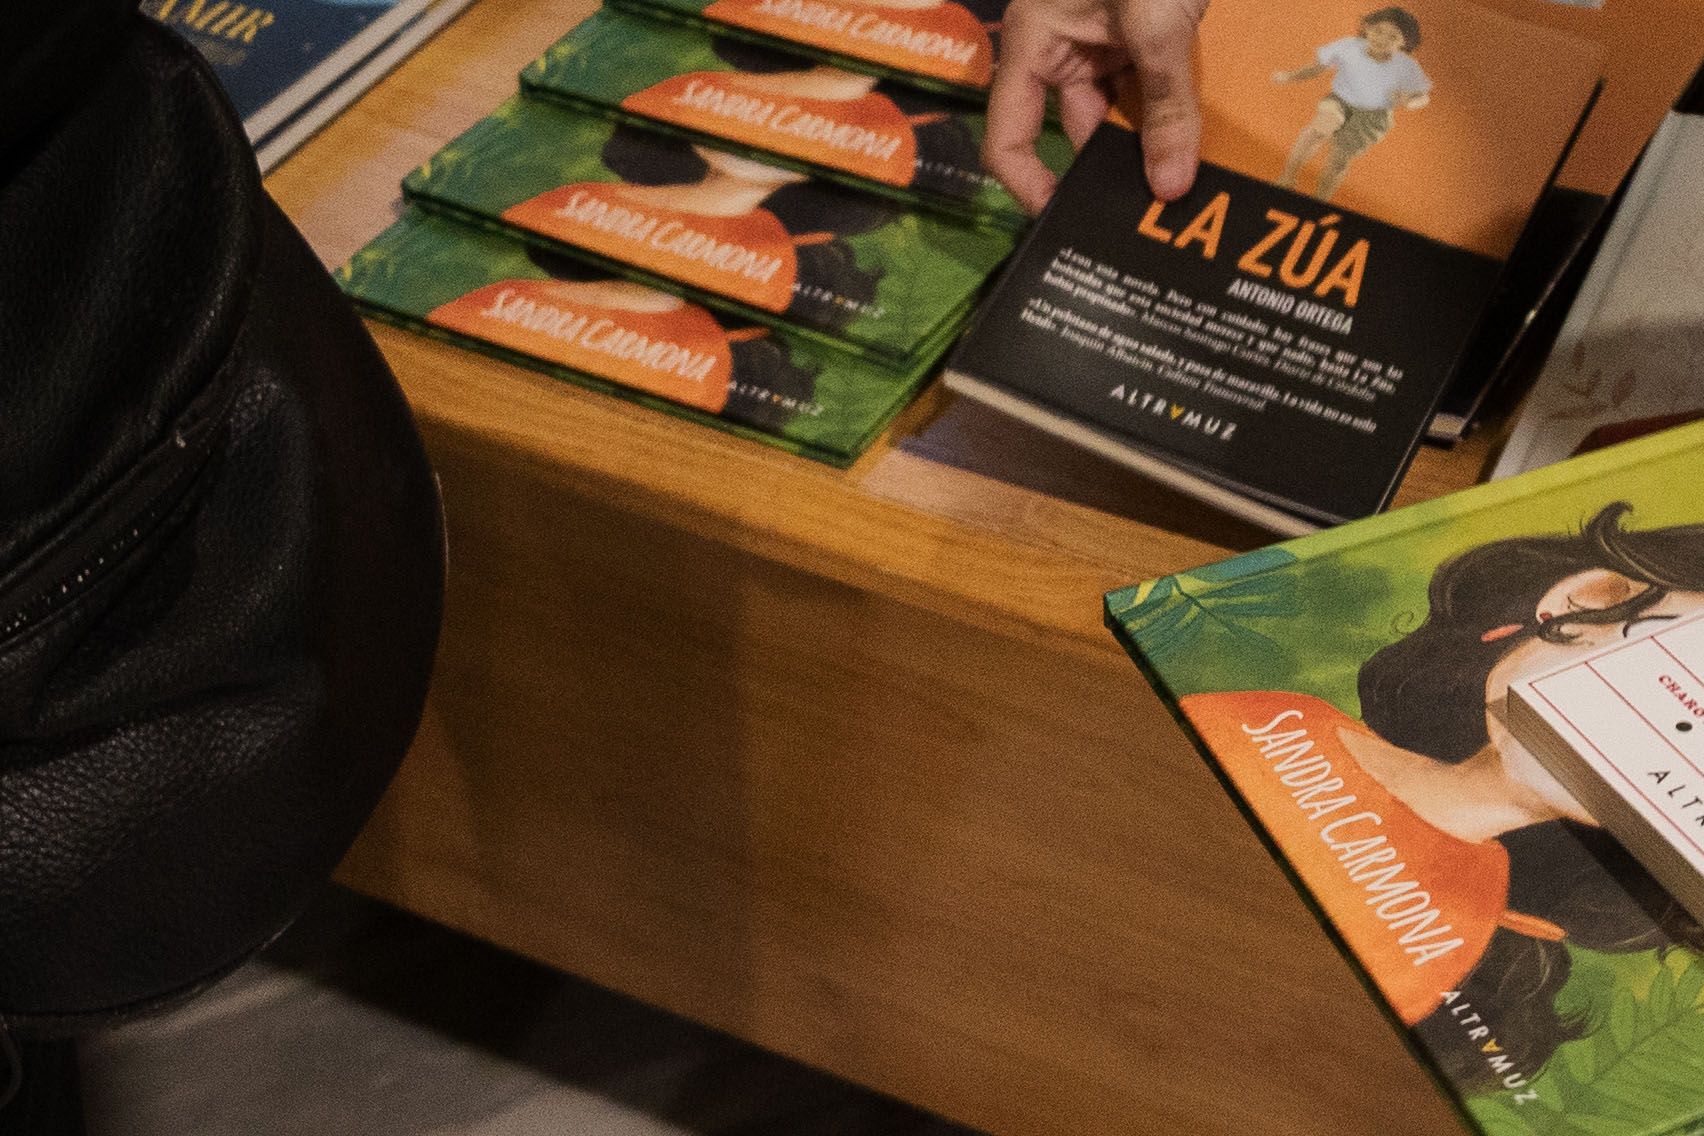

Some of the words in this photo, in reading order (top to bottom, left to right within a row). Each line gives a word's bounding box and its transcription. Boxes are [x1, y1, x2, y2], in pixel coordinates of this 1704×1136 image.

[850, 13, 980, 65] CARMONA
[673, 80, 775, 126] SANDRA
[770, 105, 902, 161] CARMONA
[561, 190, 657, 241] SANDRA
[650, 220, 783, 283] CARMONA
[1137, 191, 1231, 261] LA
[1238, 209, 1372, 308] ZÚA
[480, 289, 588, 342] SANDRA
[580, 320, 718, 383] CARMONA
[1227, 278, 1295, 313] ANTONIO
[1295, 300, 1354, 336] ORTEGA
[1241, 710, 1357, 821] SANDRA
[1319, 811, 1465, 966] CARMONA
